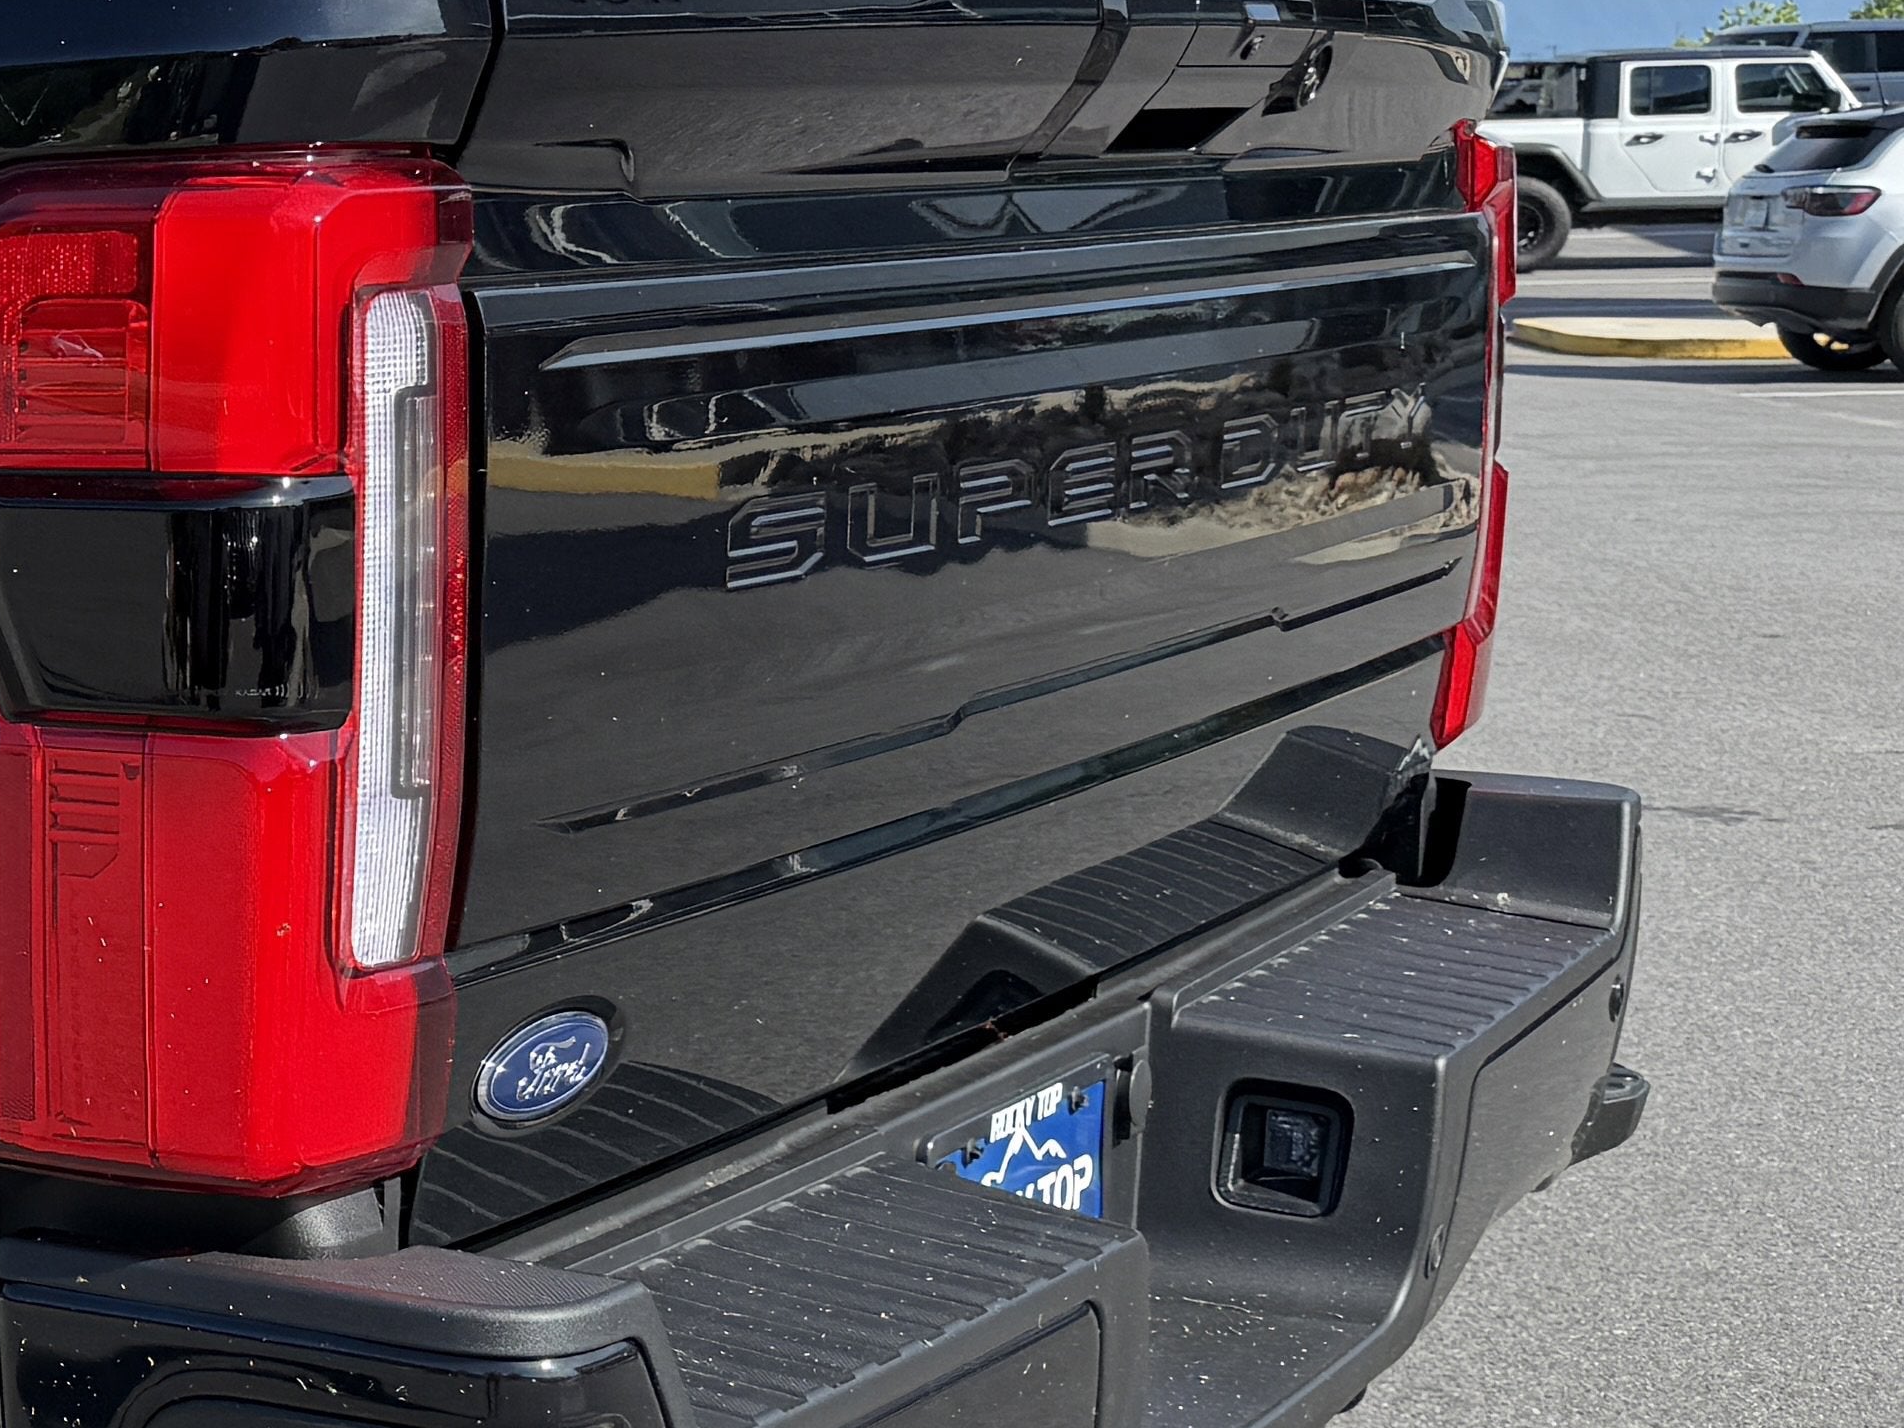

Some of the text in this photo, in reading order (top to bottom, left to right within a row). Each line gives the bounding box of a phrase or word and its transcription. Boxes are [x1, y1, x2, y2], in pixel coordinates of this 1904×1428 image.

[725, 382, 1428, 590] SUPER DUTY
[515, 1034, 591, 1102] Ford
[990, 1082, 1064, 1143] ROCKY TOP
[1037, 1154, 1093, 1211] TOP
